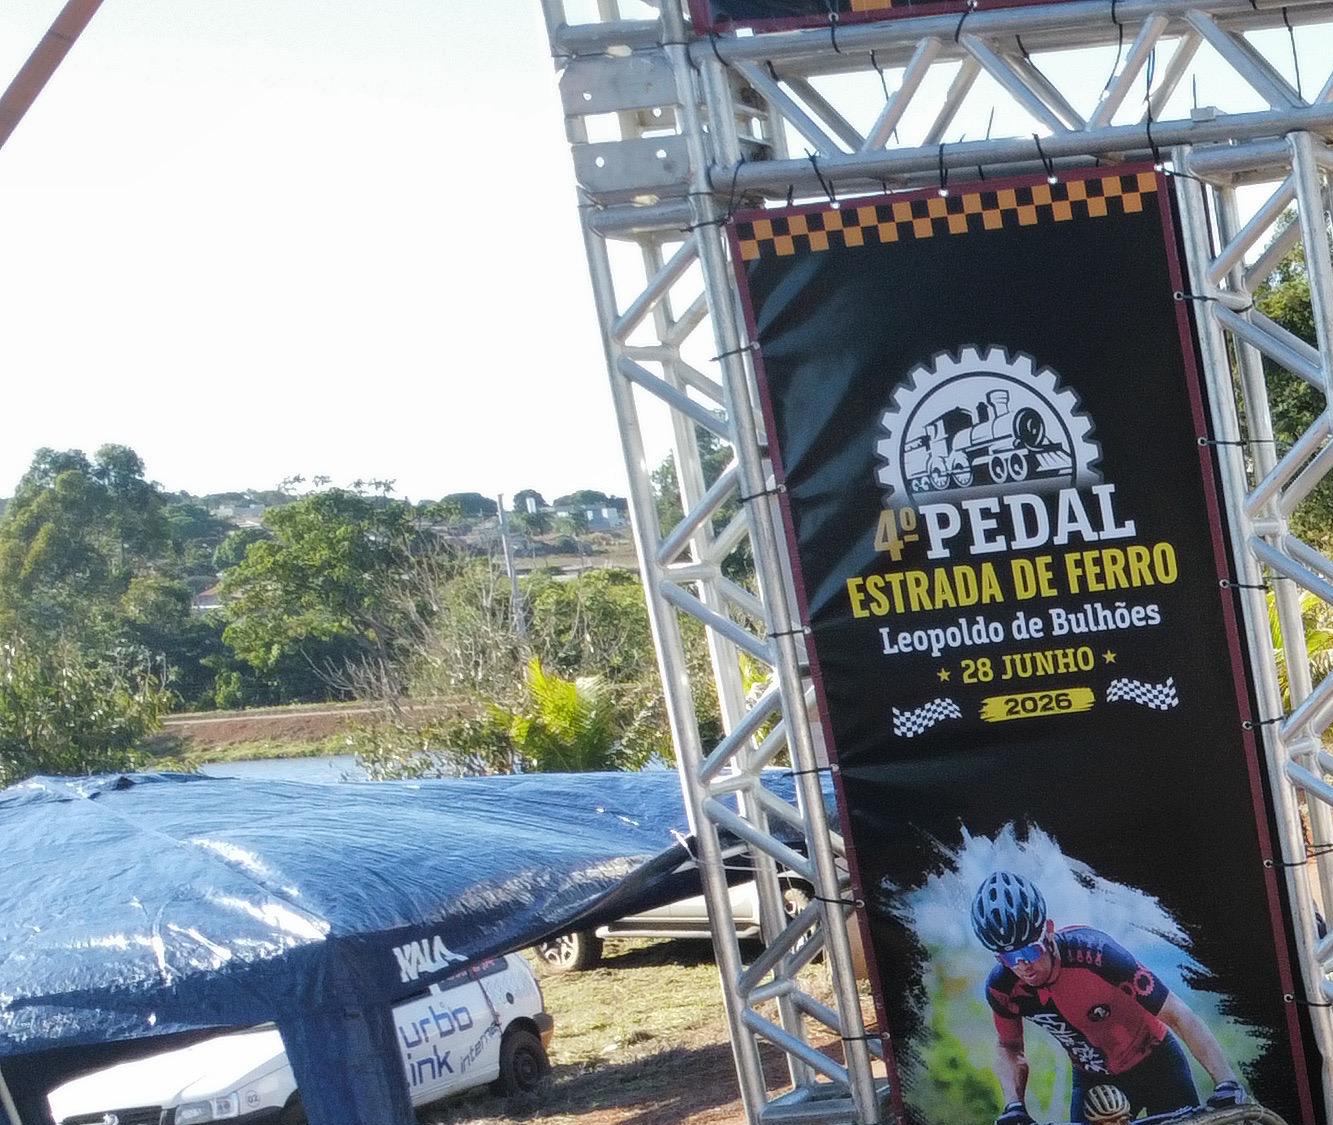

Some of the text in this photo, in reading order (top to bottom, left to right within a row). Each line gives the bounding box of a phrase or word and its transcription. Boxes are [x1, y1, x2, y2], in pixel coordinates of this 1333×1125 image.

[873, 483, 1136, 562] 4º PEDAL
[847, 542, 1178, 619] ESTRADA DE FERRO
[879, 599, 1161, 658] Leopoldo de Bulhões
[960, 646, 1095, 683] 28 JUNHO
[1003, 692, 1073, 717] 2026
[399, 1006, 473, 1048] urbo
[407, 1045, 453, 1086] ink
